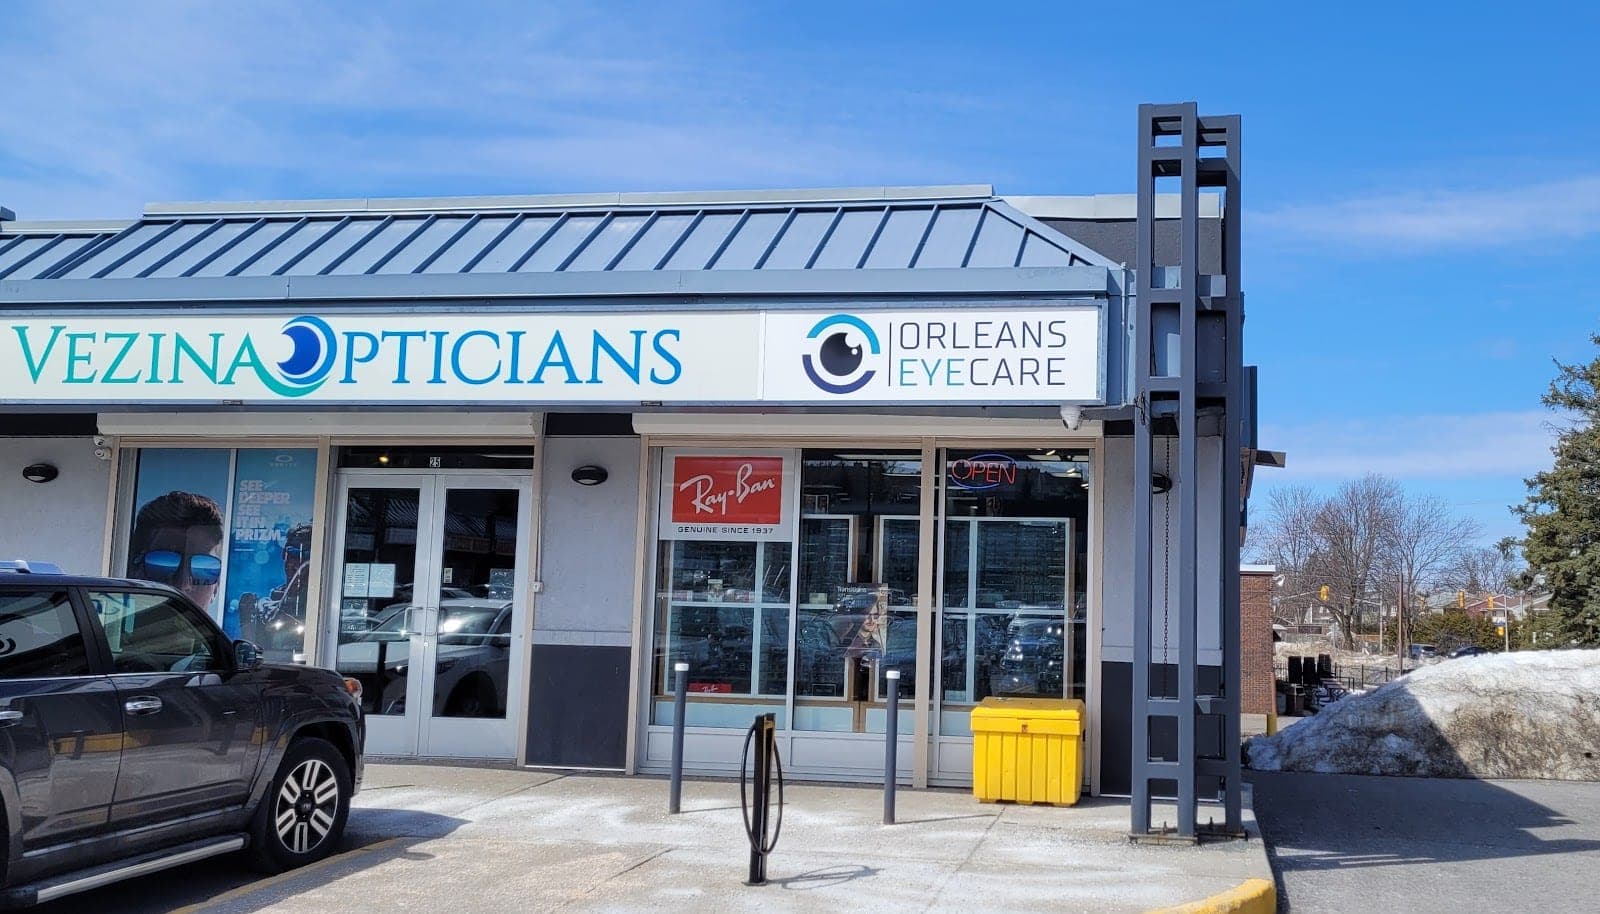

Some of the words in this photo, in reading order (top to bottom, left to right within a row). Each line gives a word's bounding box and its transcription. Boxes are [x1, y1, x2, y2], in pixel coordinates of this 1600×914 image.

[899, 320, 1067, 350] ORLEANS
[11, 325, 262, 385] VEZINA
[899, 357, 1066, 387] EYECARE
[430, 457, 440, 467] 25
[951, 459, 1017, 485] OPEN
[239, 480, 263, 492] SEE
[679, 463, 776, 516] Ray-Ban
[238, 492, 290, 505] DEEPER
[238, 504, 261, 516] SEE
[678, 526, 717, 535] GENUINE
[721, 527, 749, 535] SINCE
[751, 527, 774, 535] 1937
